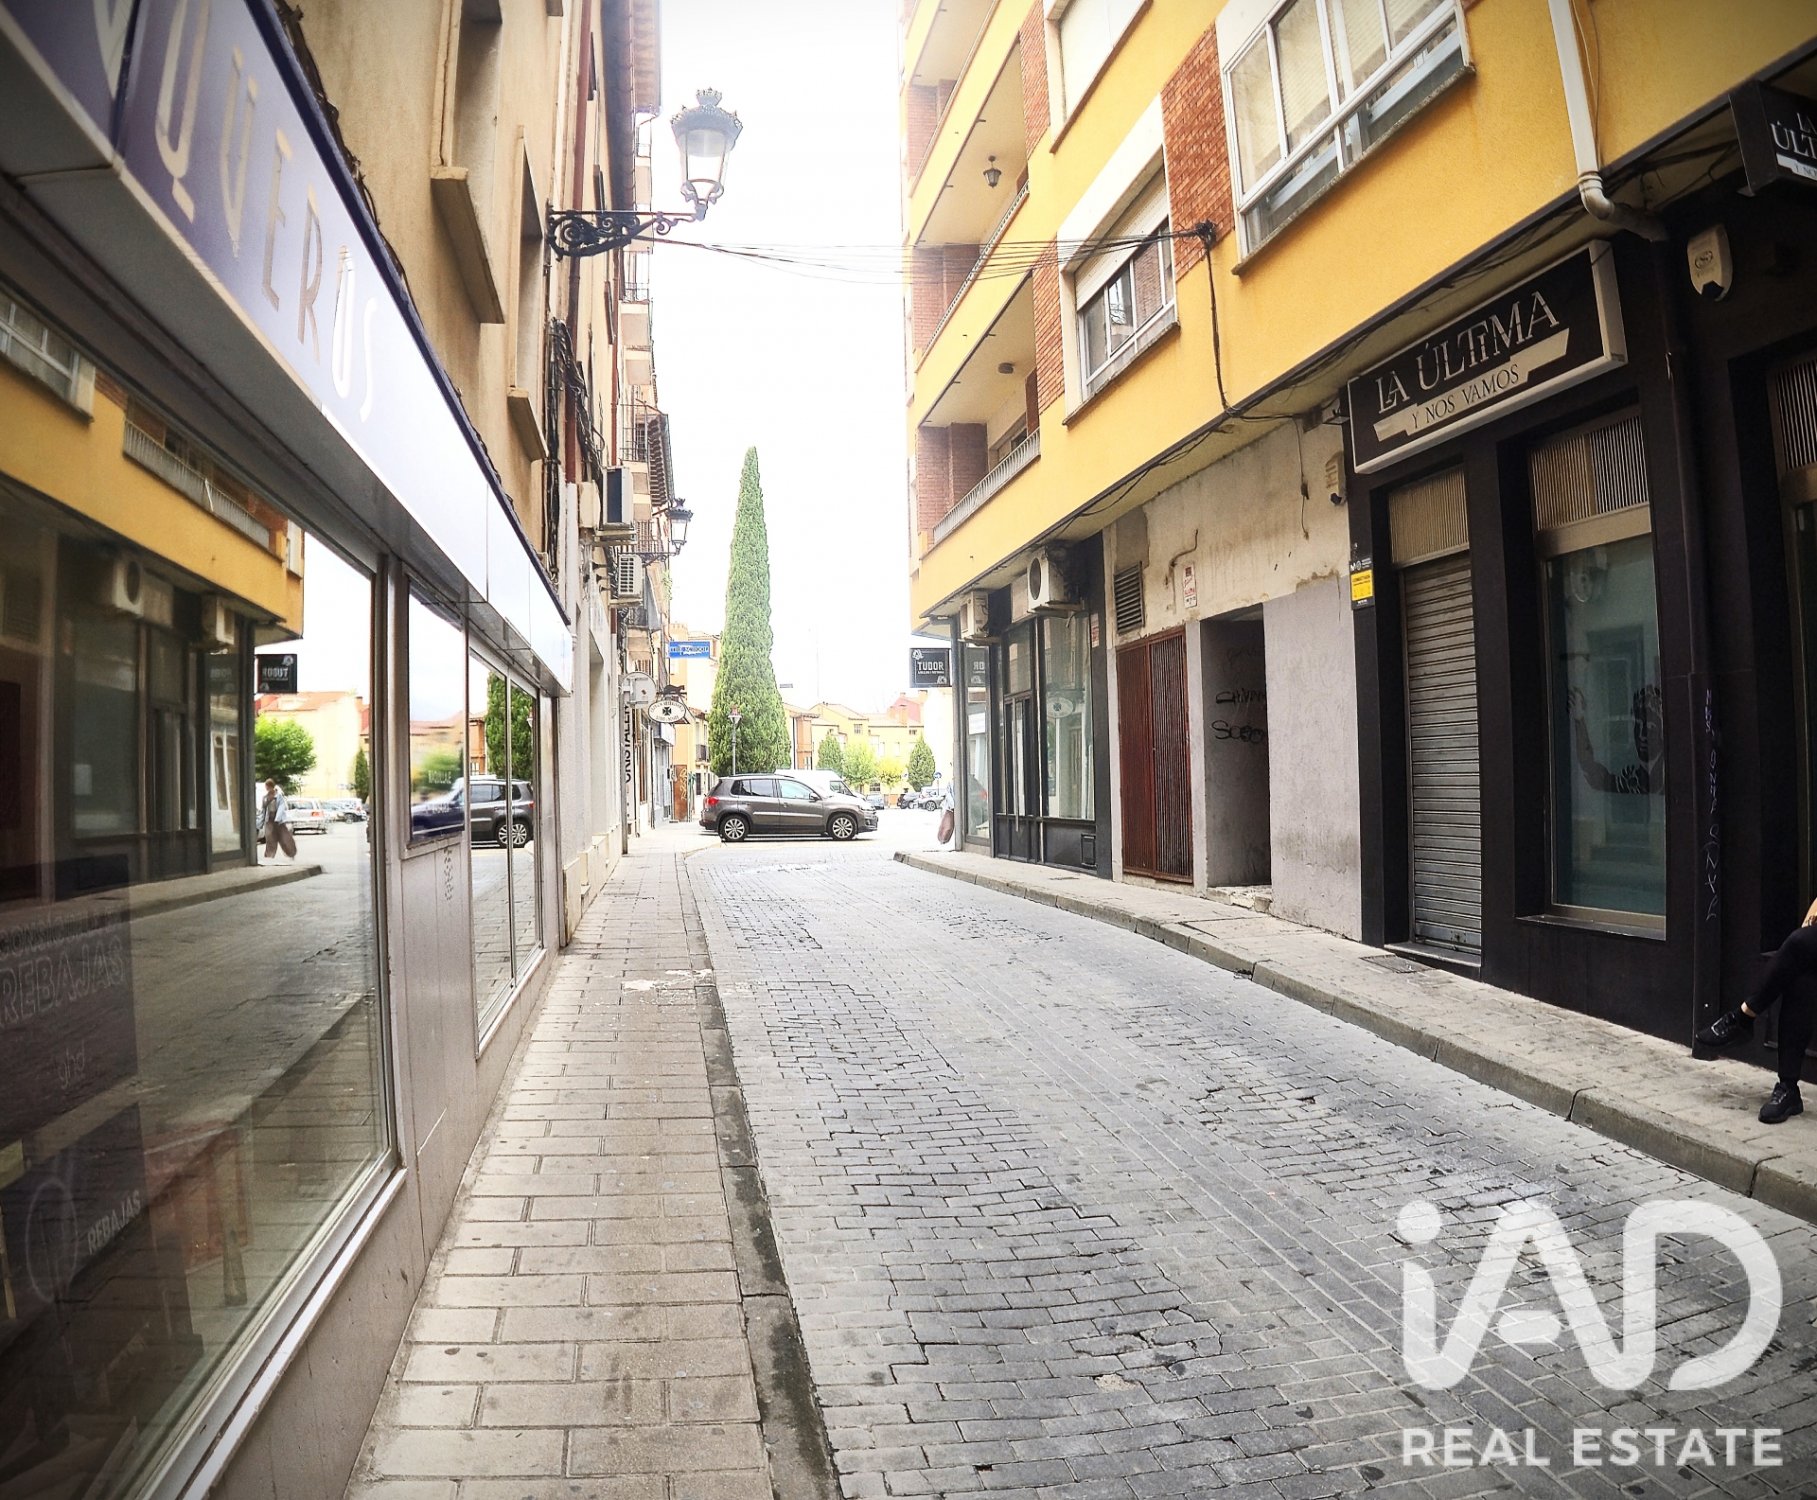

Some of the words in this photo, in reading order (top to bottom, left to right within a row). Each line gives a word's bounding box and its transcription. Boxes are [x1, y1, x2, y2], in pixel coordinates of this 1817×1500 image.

[1375, 370, 1410, 414] LA
[1416, 290, 1560, 391] ÚLTIMA
[1411, 408, 1419, 429] Y
[1425, 394, 1456, 425] NOS
[1462, 363, 1520, 406] VAMOS
[917, 661, 945, 671] TUDOR
[0, 934, 125, 1028] REBAJAS
[87, 1189, 142, 1256] REBAJAS
